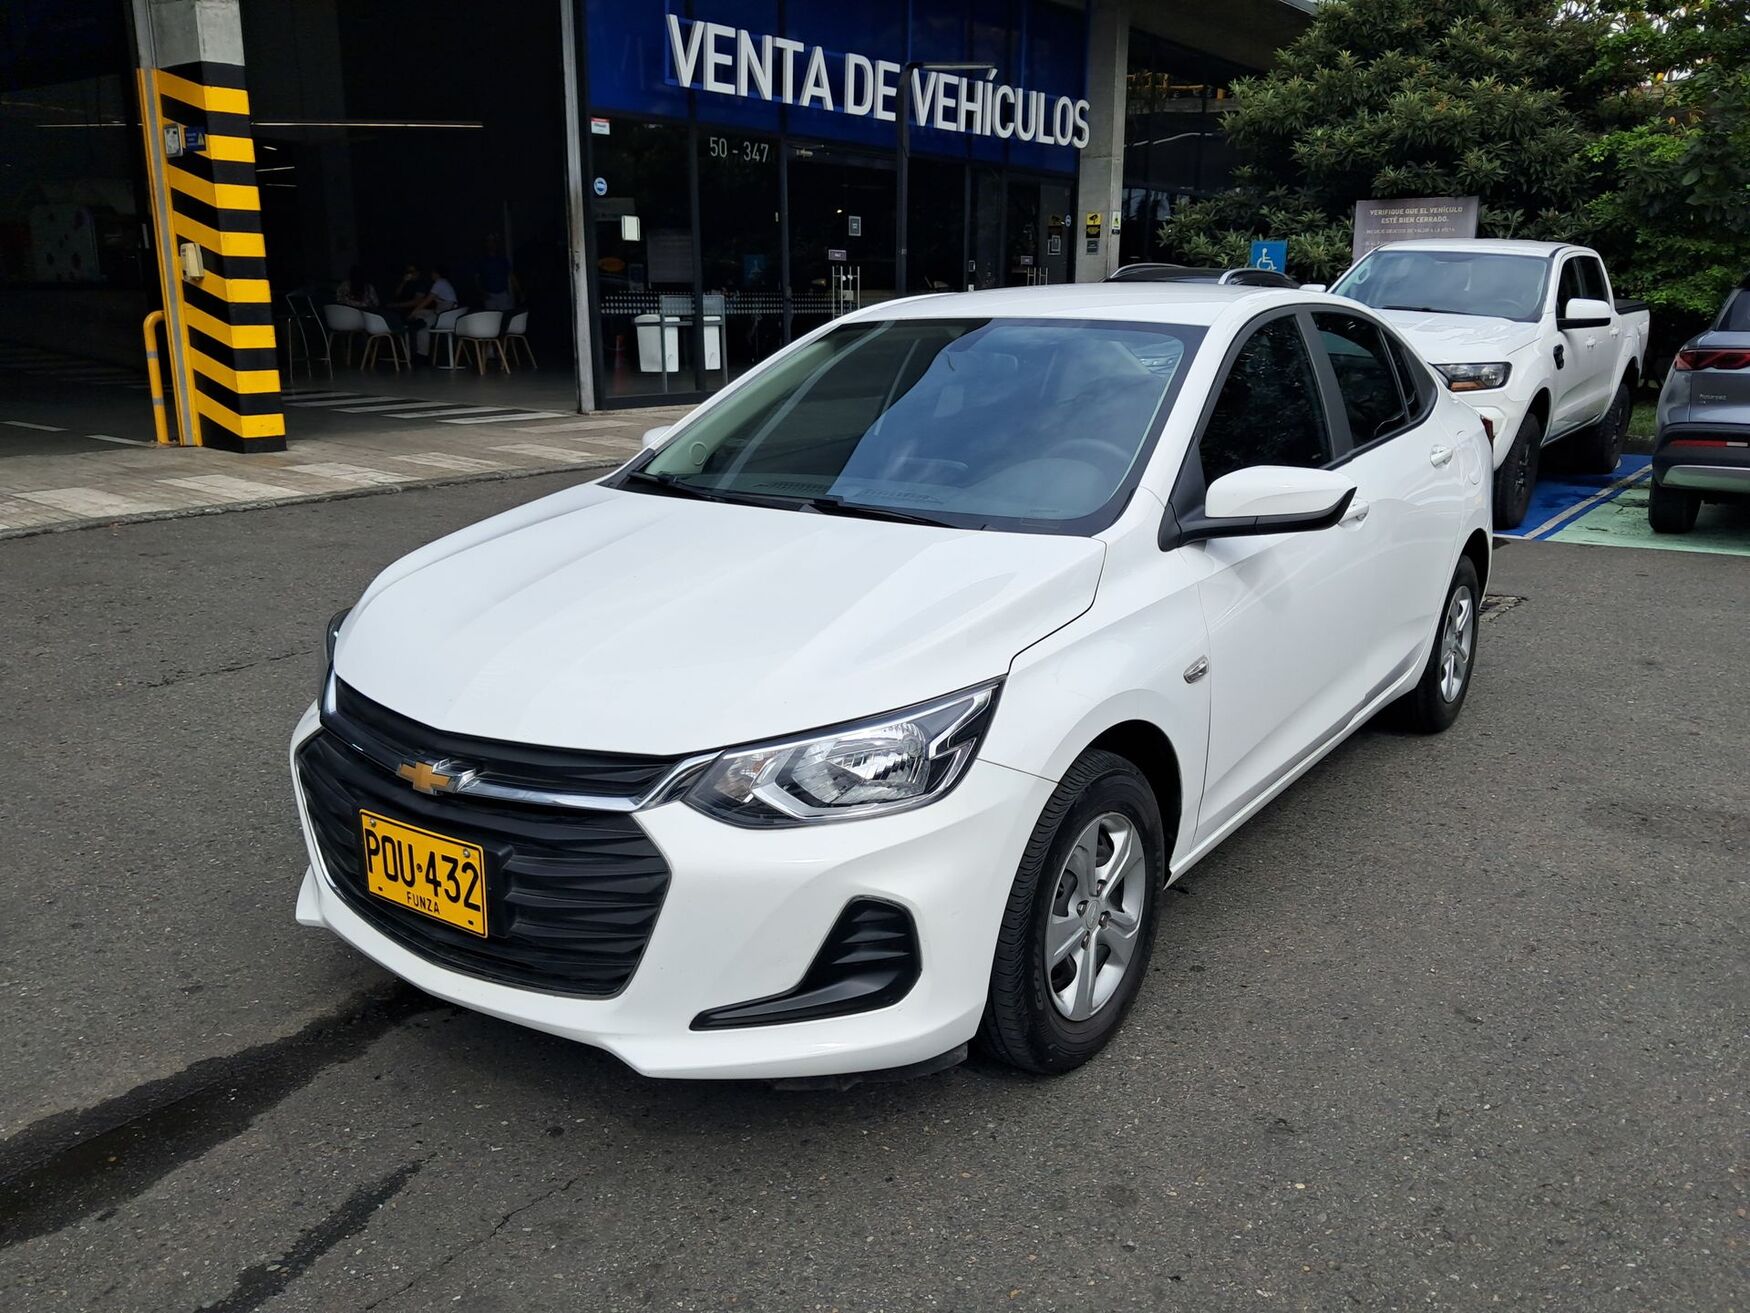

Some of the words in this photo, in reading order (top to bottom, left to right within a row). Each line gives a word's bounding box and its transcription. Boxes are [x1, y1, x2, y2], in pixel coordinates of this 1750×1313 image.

[666, 14, 834, 111] VENTA
[844, 53, 900, 121] DE
[911, 68, 1091, 149] VEHÍCULOS
[709, 137, 727, 157] 50
[743, 142, 769, 163] 347
[406, 891, 440, 914] FUNZA
